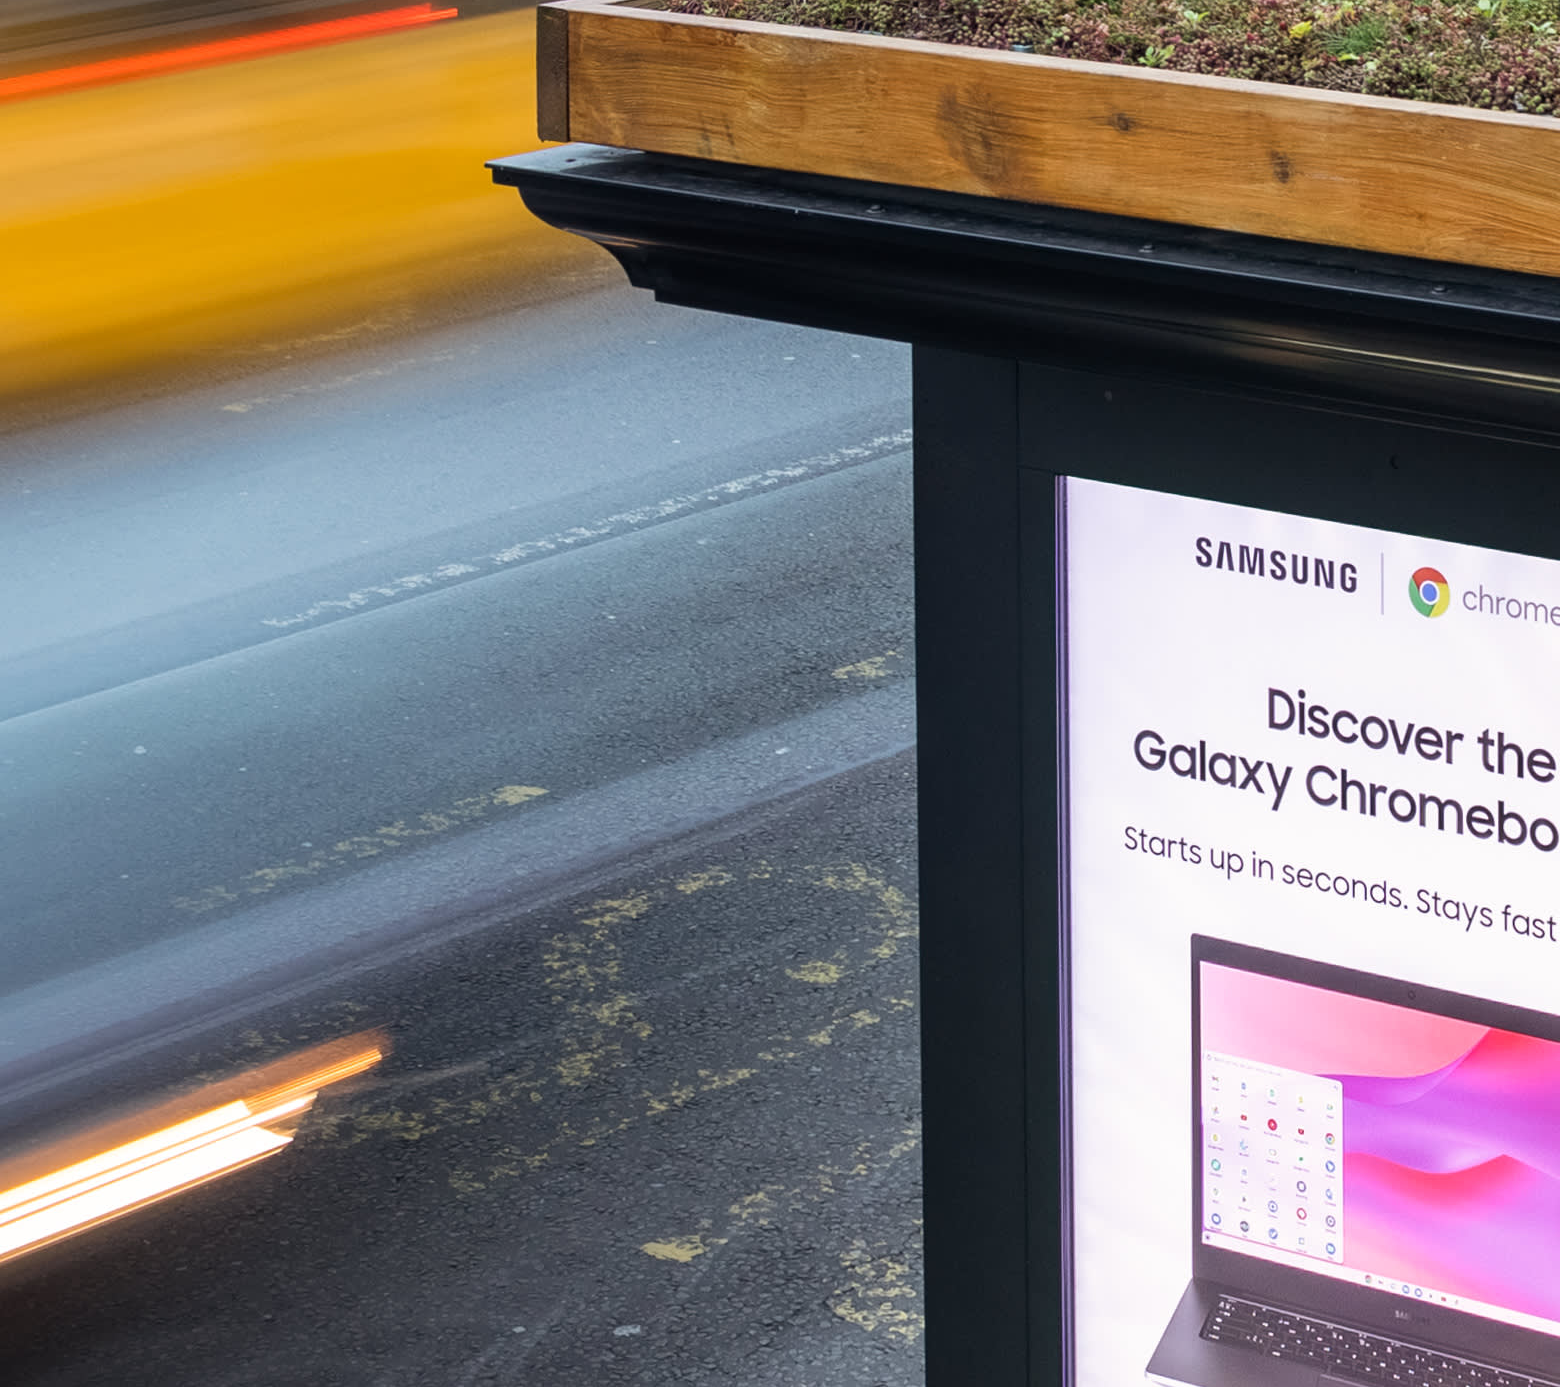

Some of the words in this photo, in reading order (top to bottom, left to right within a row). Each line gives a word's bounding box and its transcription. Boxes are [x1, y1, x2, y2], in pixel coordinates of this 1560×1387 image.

[1195, 537, 1359, 594] SAMSUNG
[1133, 729, 1294, 811] Galaxy
[1267, 687, 1464, 767] Discover
[1478, 728, 1557, 784] the
[1124, 825, 1202, 867] Starts
[1210, 847, 1244, 881] up
[1251, 850, 1275, 883] in
[1282, 863, 1409, 912] seconds.
[1415, 889, 1494, 934] Stays
[1501, 904, 1558, 944] fast
